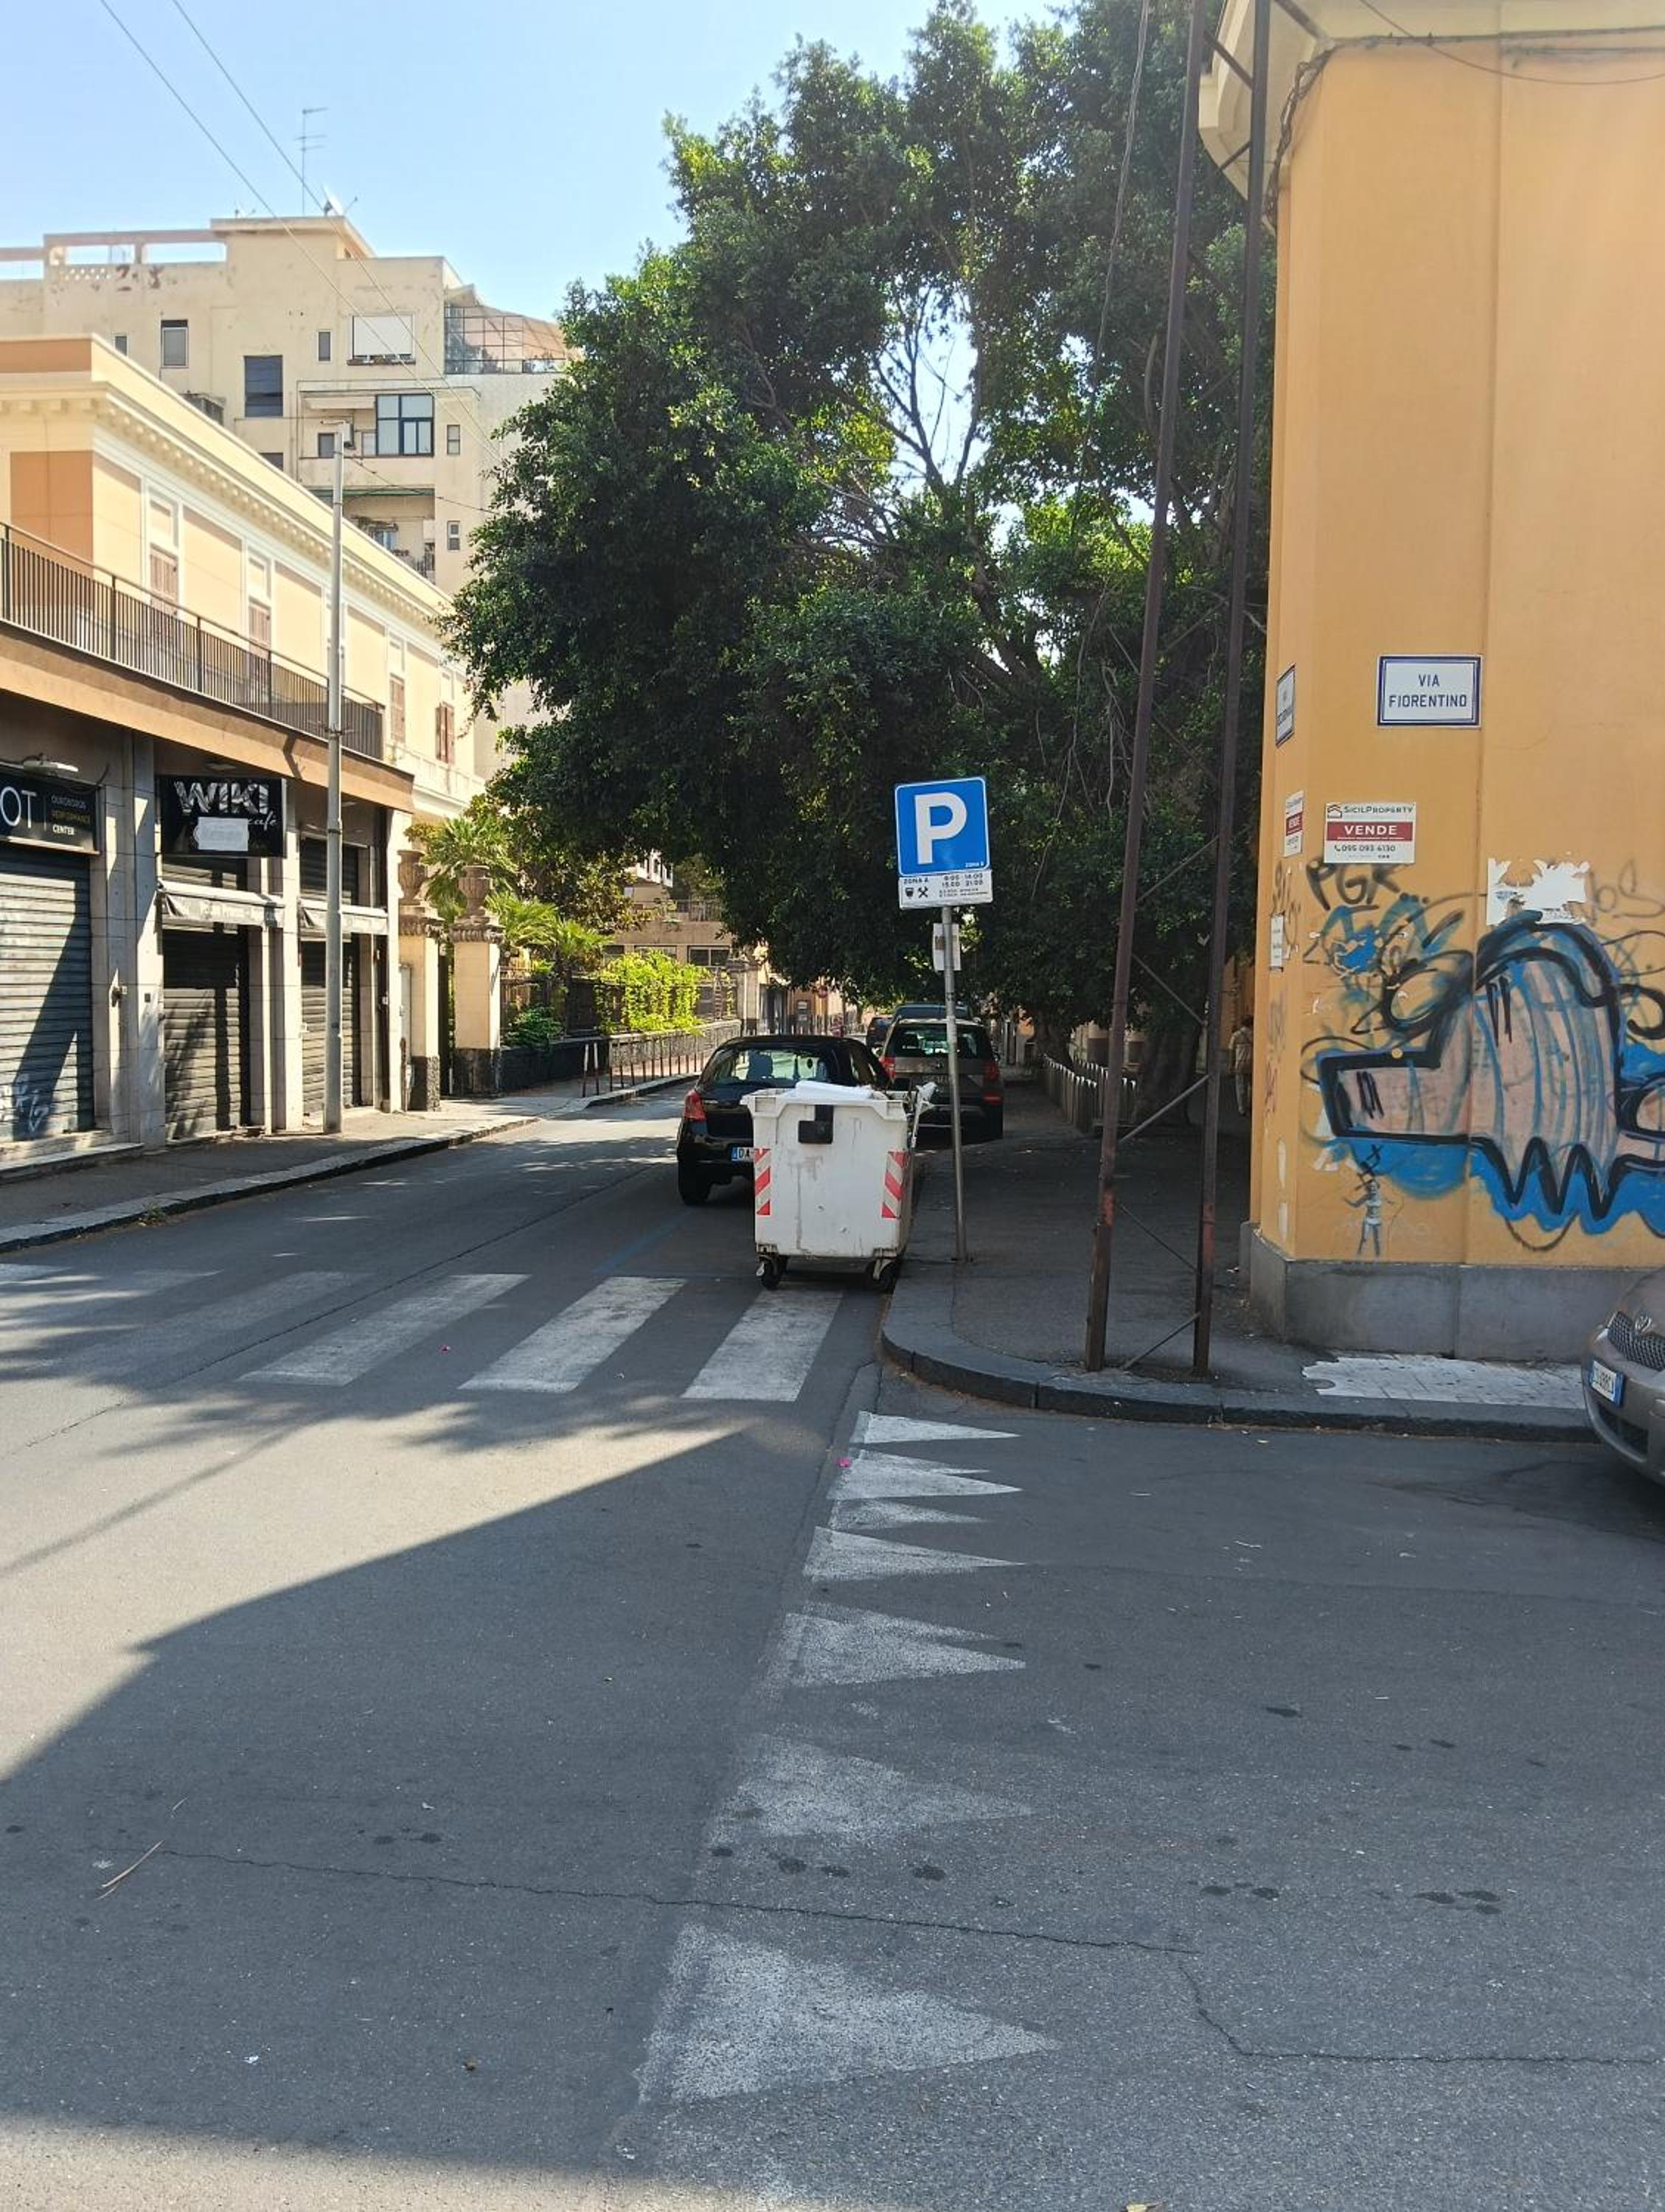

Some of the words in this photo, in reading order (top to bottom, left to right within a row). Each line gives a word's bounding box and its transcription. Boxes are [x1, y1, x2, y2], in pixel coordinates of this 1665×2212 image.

[1418, 674, 1440, 687] VIA
[1388, 694, 1467, 708] FIORENTINO
[173, 780, 269, 814] WIKI
[52, 824, 75, 835] CENTER
[914, 792, 967, 865] P
[1344, 824, 1398, 835] VENDE
